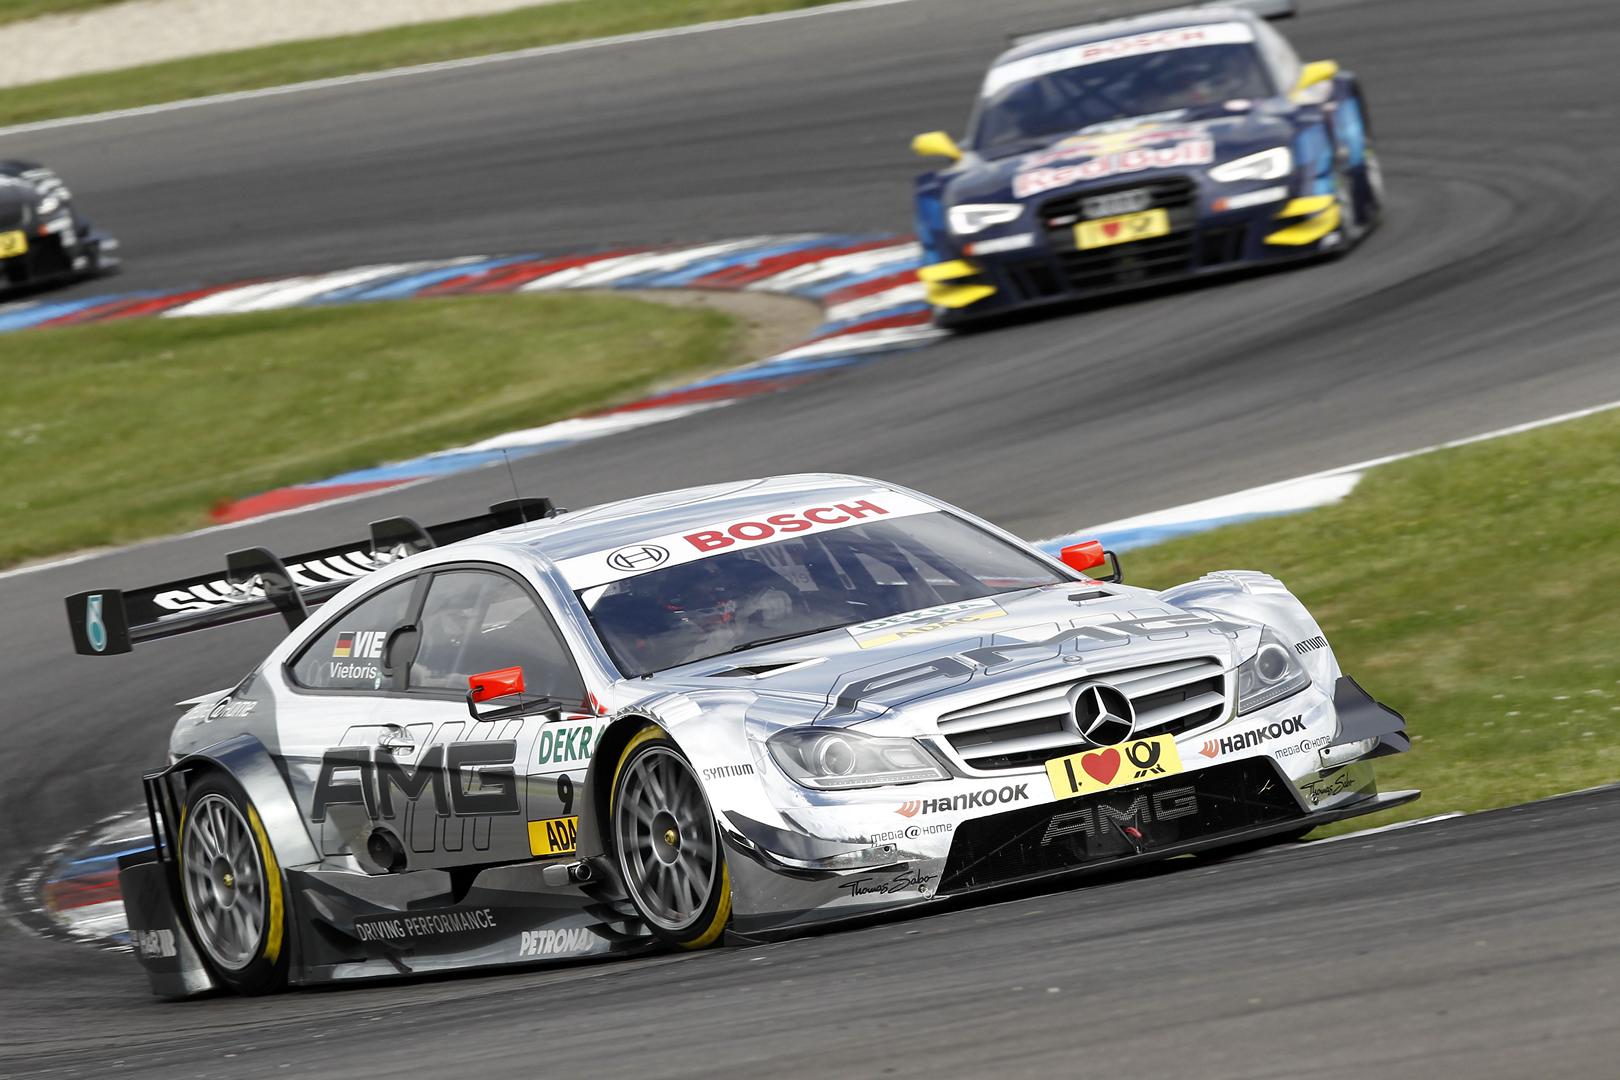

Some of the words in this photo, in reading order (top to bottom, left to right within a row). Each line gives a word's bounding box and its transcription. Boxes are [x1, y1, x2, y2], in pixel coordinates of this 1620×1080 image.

[683, 500, 890, 552] BOSCH
[896, 616, 982, 639] ADAC
[353, 631, 387, 658] VIE
[329, 661, 377, 679] Vietoris
[311, 739, 520, 823] AMG
[702, 763, 755, 781] SYNTIUM
[557, 773, 574, 815] 9
[1040, 786, 1199, 847] AMG
[838, 877, 889, 898] Thomas
[887, 868, 938, 894] Sabo
[356, 919, 405, 941] DRIVING
[404, 908, 497, 936] PERFORMANCE
